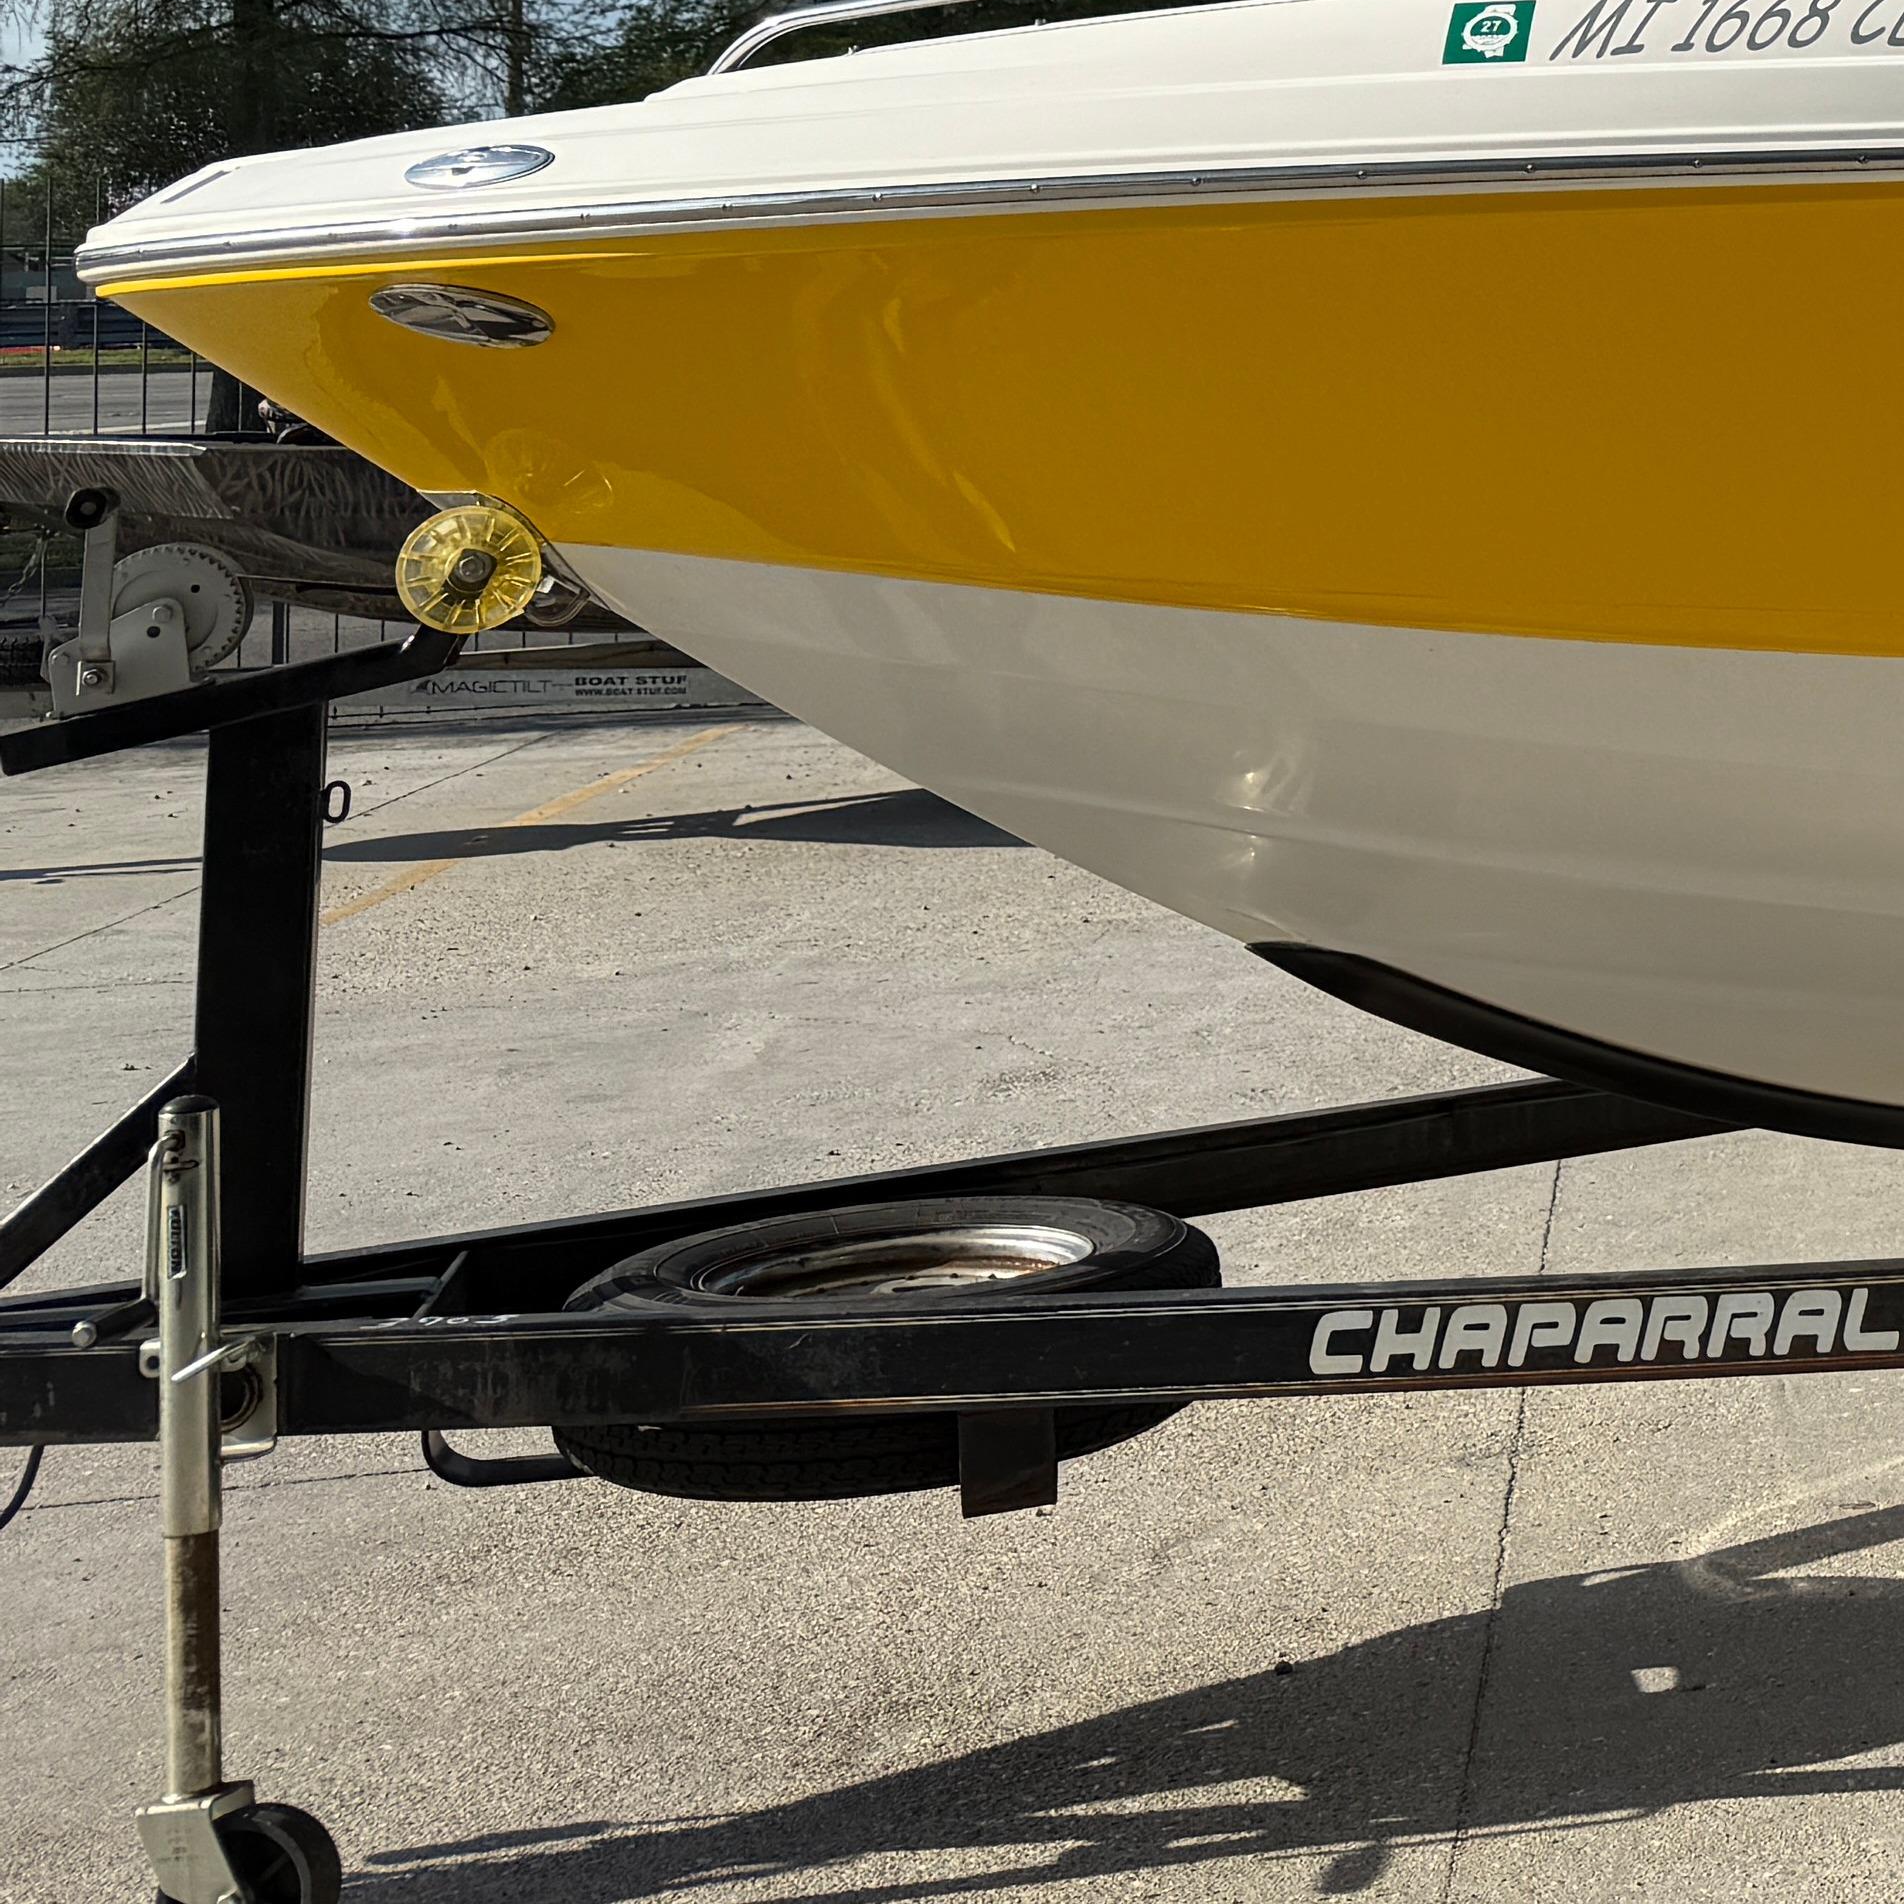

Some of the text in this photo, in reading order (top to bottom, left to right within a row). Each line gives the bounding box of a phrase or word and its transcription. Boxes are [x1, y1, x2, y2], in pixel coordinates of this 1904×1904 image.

[1480, 20, 1502, 33] 27
[575, 676, 629, 686] BOAT
[1310, 1287, 1899, 1376] CHAPARRAL
